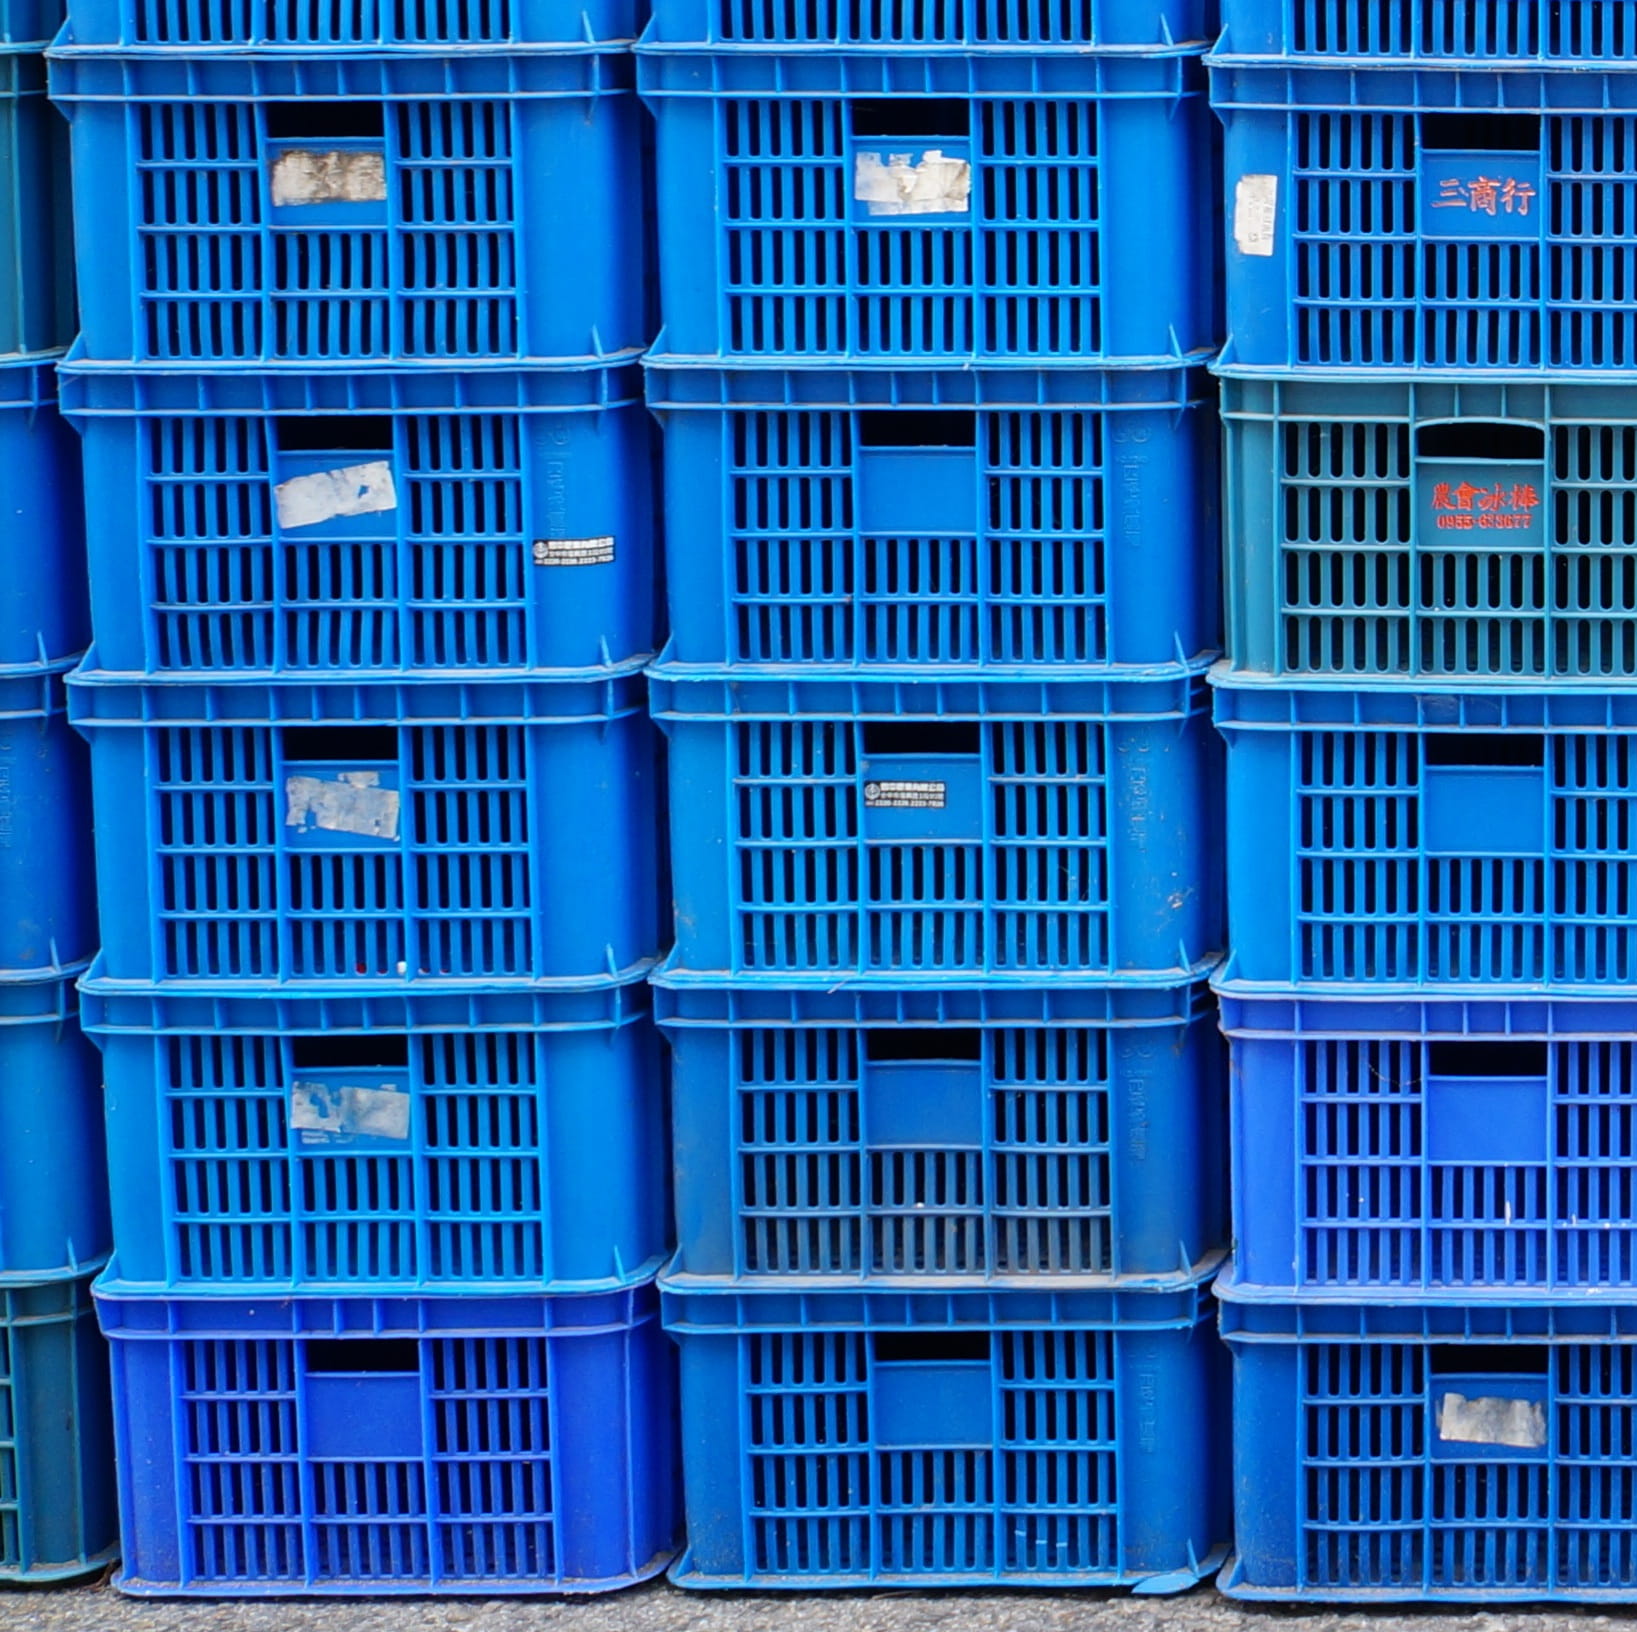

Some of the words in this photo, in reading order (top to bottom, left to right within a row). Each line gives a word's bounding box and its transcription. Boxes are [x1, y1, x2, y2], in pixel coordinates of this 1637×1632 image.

[1431, 176, 1536, 216] 三商行
[1432, 482, 1539, 512] 農會冰棒
